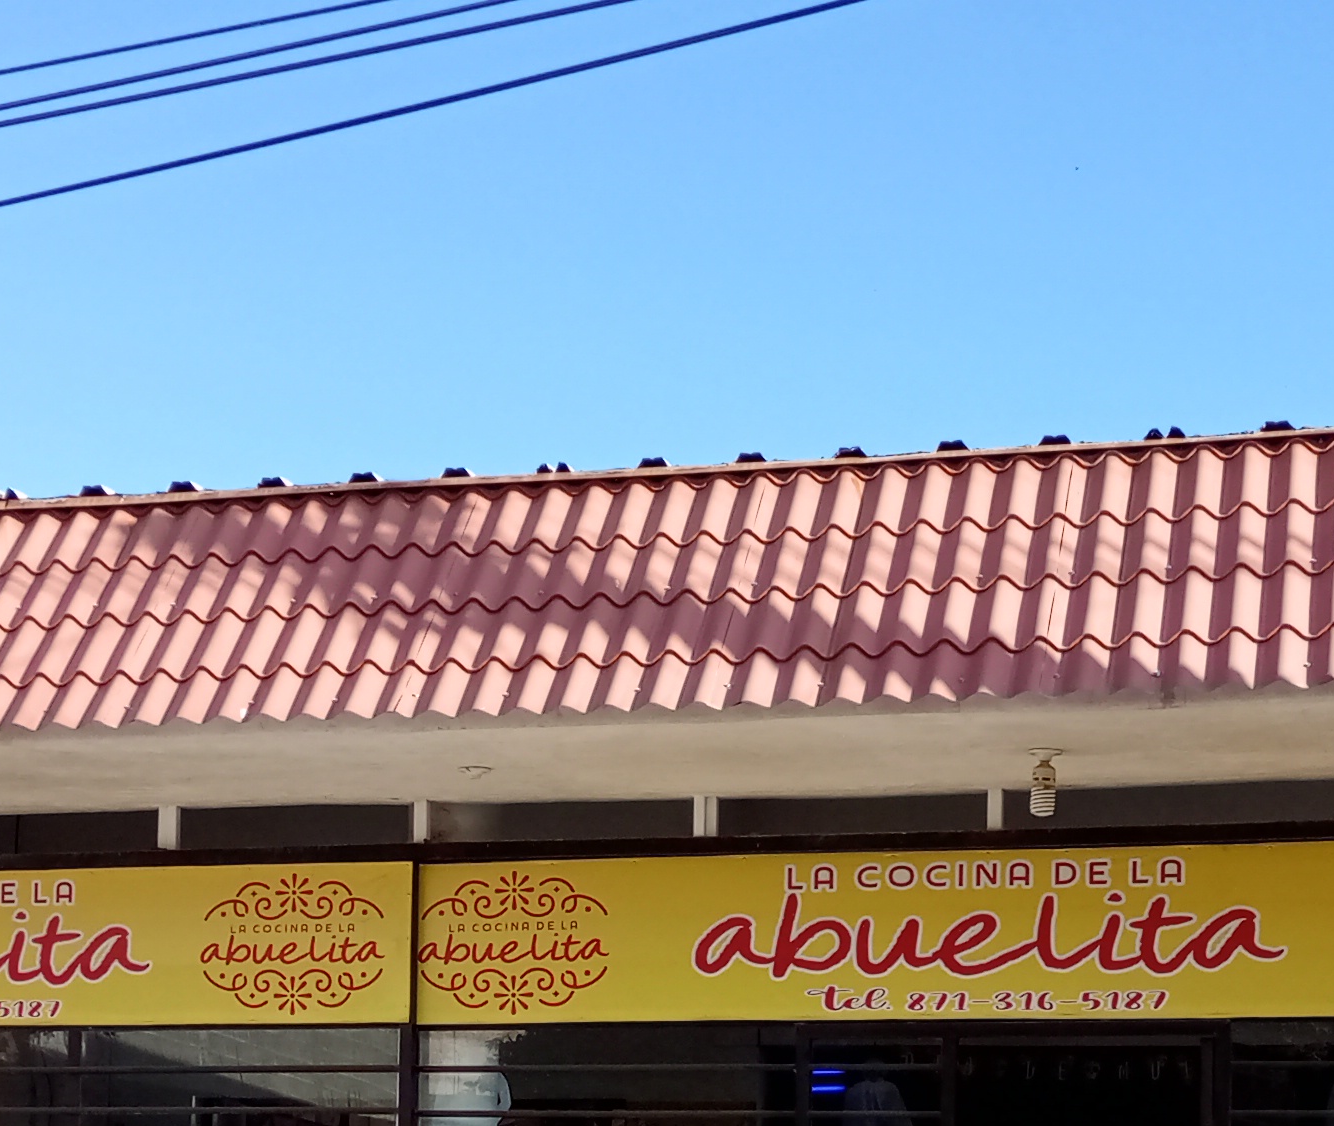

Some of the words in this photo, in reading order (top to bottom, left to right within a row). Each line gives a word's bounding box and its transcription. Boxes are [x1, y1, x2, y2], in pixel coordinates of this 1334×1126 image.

[787, 866, 834, 890] LA
[856, 862, 1031, 888] COCINA
[1054, 861, 1109, 886] DE
[1131, 859, 1183, 884] LA
[33, 881, 73, 904] LA
[230, 925, 246, 934] LA
[253, 924, 309, 933] COCINA
[315, 923, 332, 933] DE
[338, 923, 355, 932] LA
[448, 923, 465, 933] LA
[472, 921, 530, 932] COCINA
[536, 920, 555, 931] DE
[561, 920, 578, 931] LA
[693, 893, 1286, 977] abuelita
[200, 934, 386, 966] abuelita
[418, 932, 610, 965] abuelita
[806, 985, 891, 1012] tel.
[907, 988, 1167, 1012] 871-316-5187
